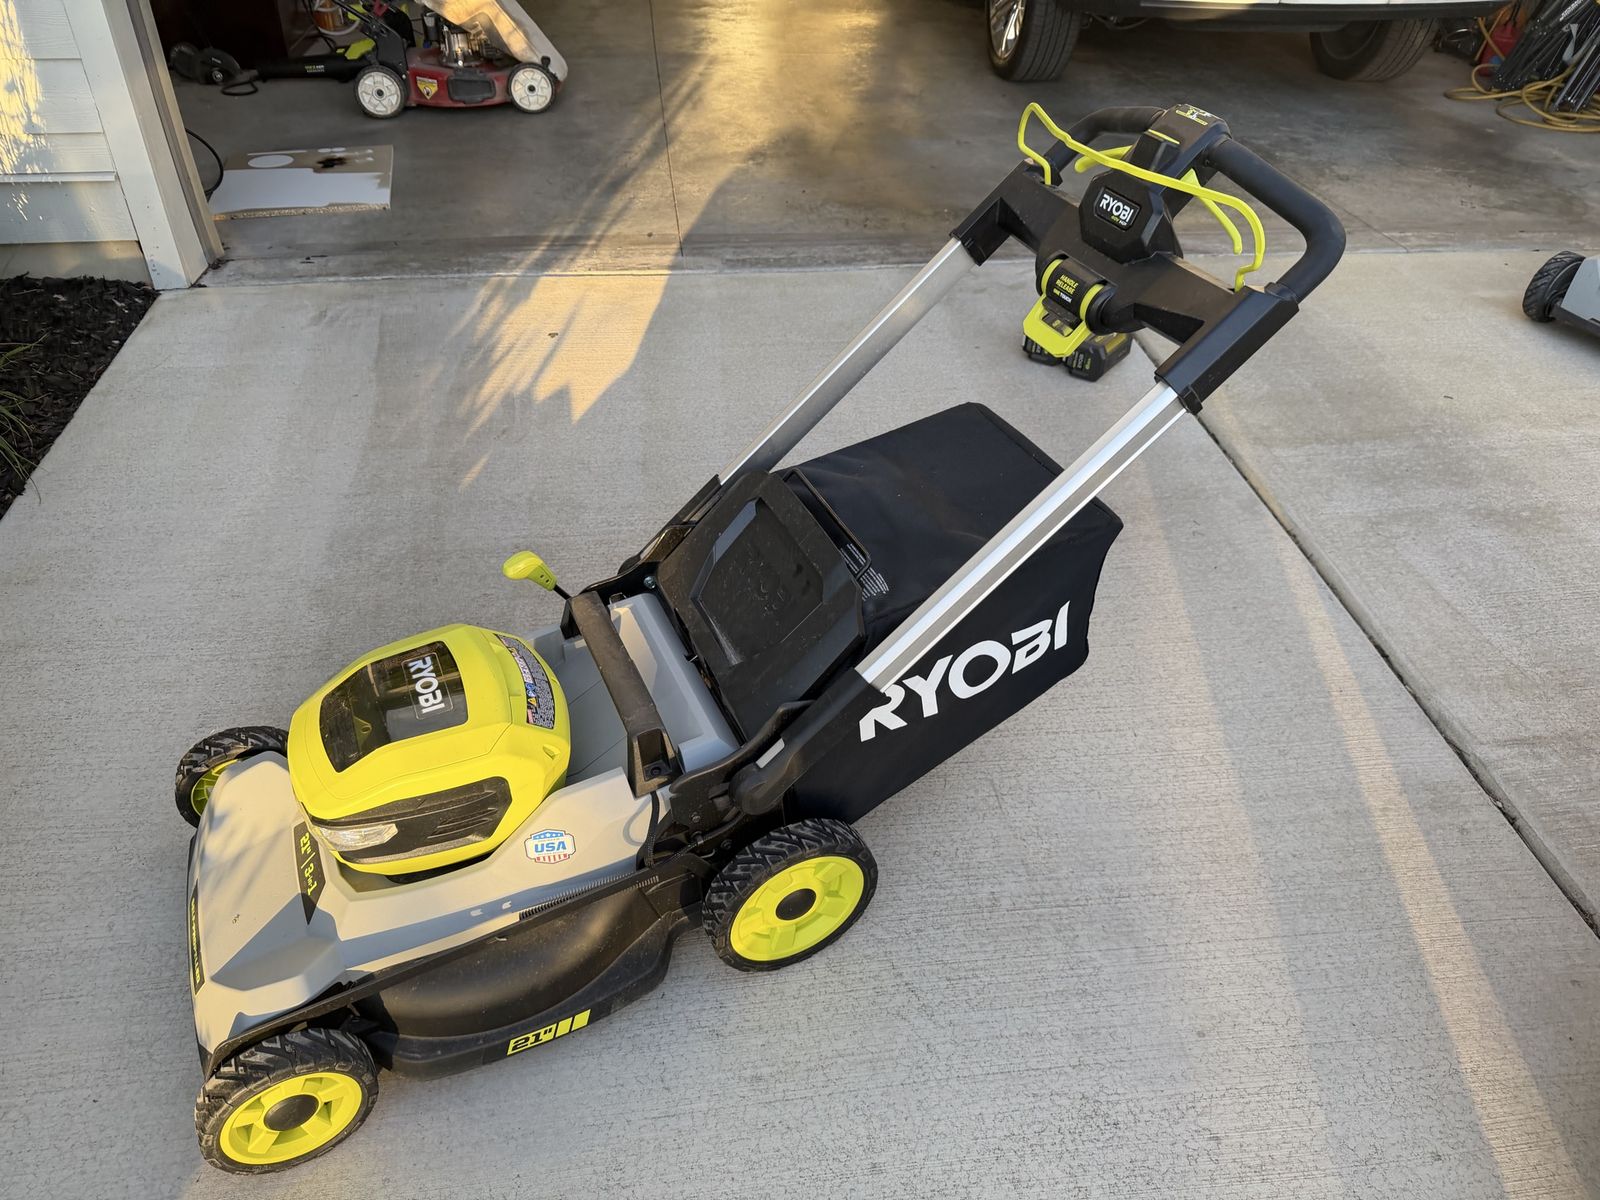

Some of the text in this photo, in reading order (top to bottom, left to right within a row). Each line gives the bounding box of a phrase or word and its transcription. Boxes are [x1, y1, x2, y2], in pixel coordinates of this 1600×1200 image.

[1100, 194, 1134, 222] RYOBI
[1055, 279, 1075, 295] RELEASE
[1060, 274, 1079, 288] HANDLE
[859, 600, 1070, 742] RYOBI
[408, 656, 445, 714] RYOBI
[534, 841, 567, 853] USA
[511, 1028, 552, 1051] 21"
